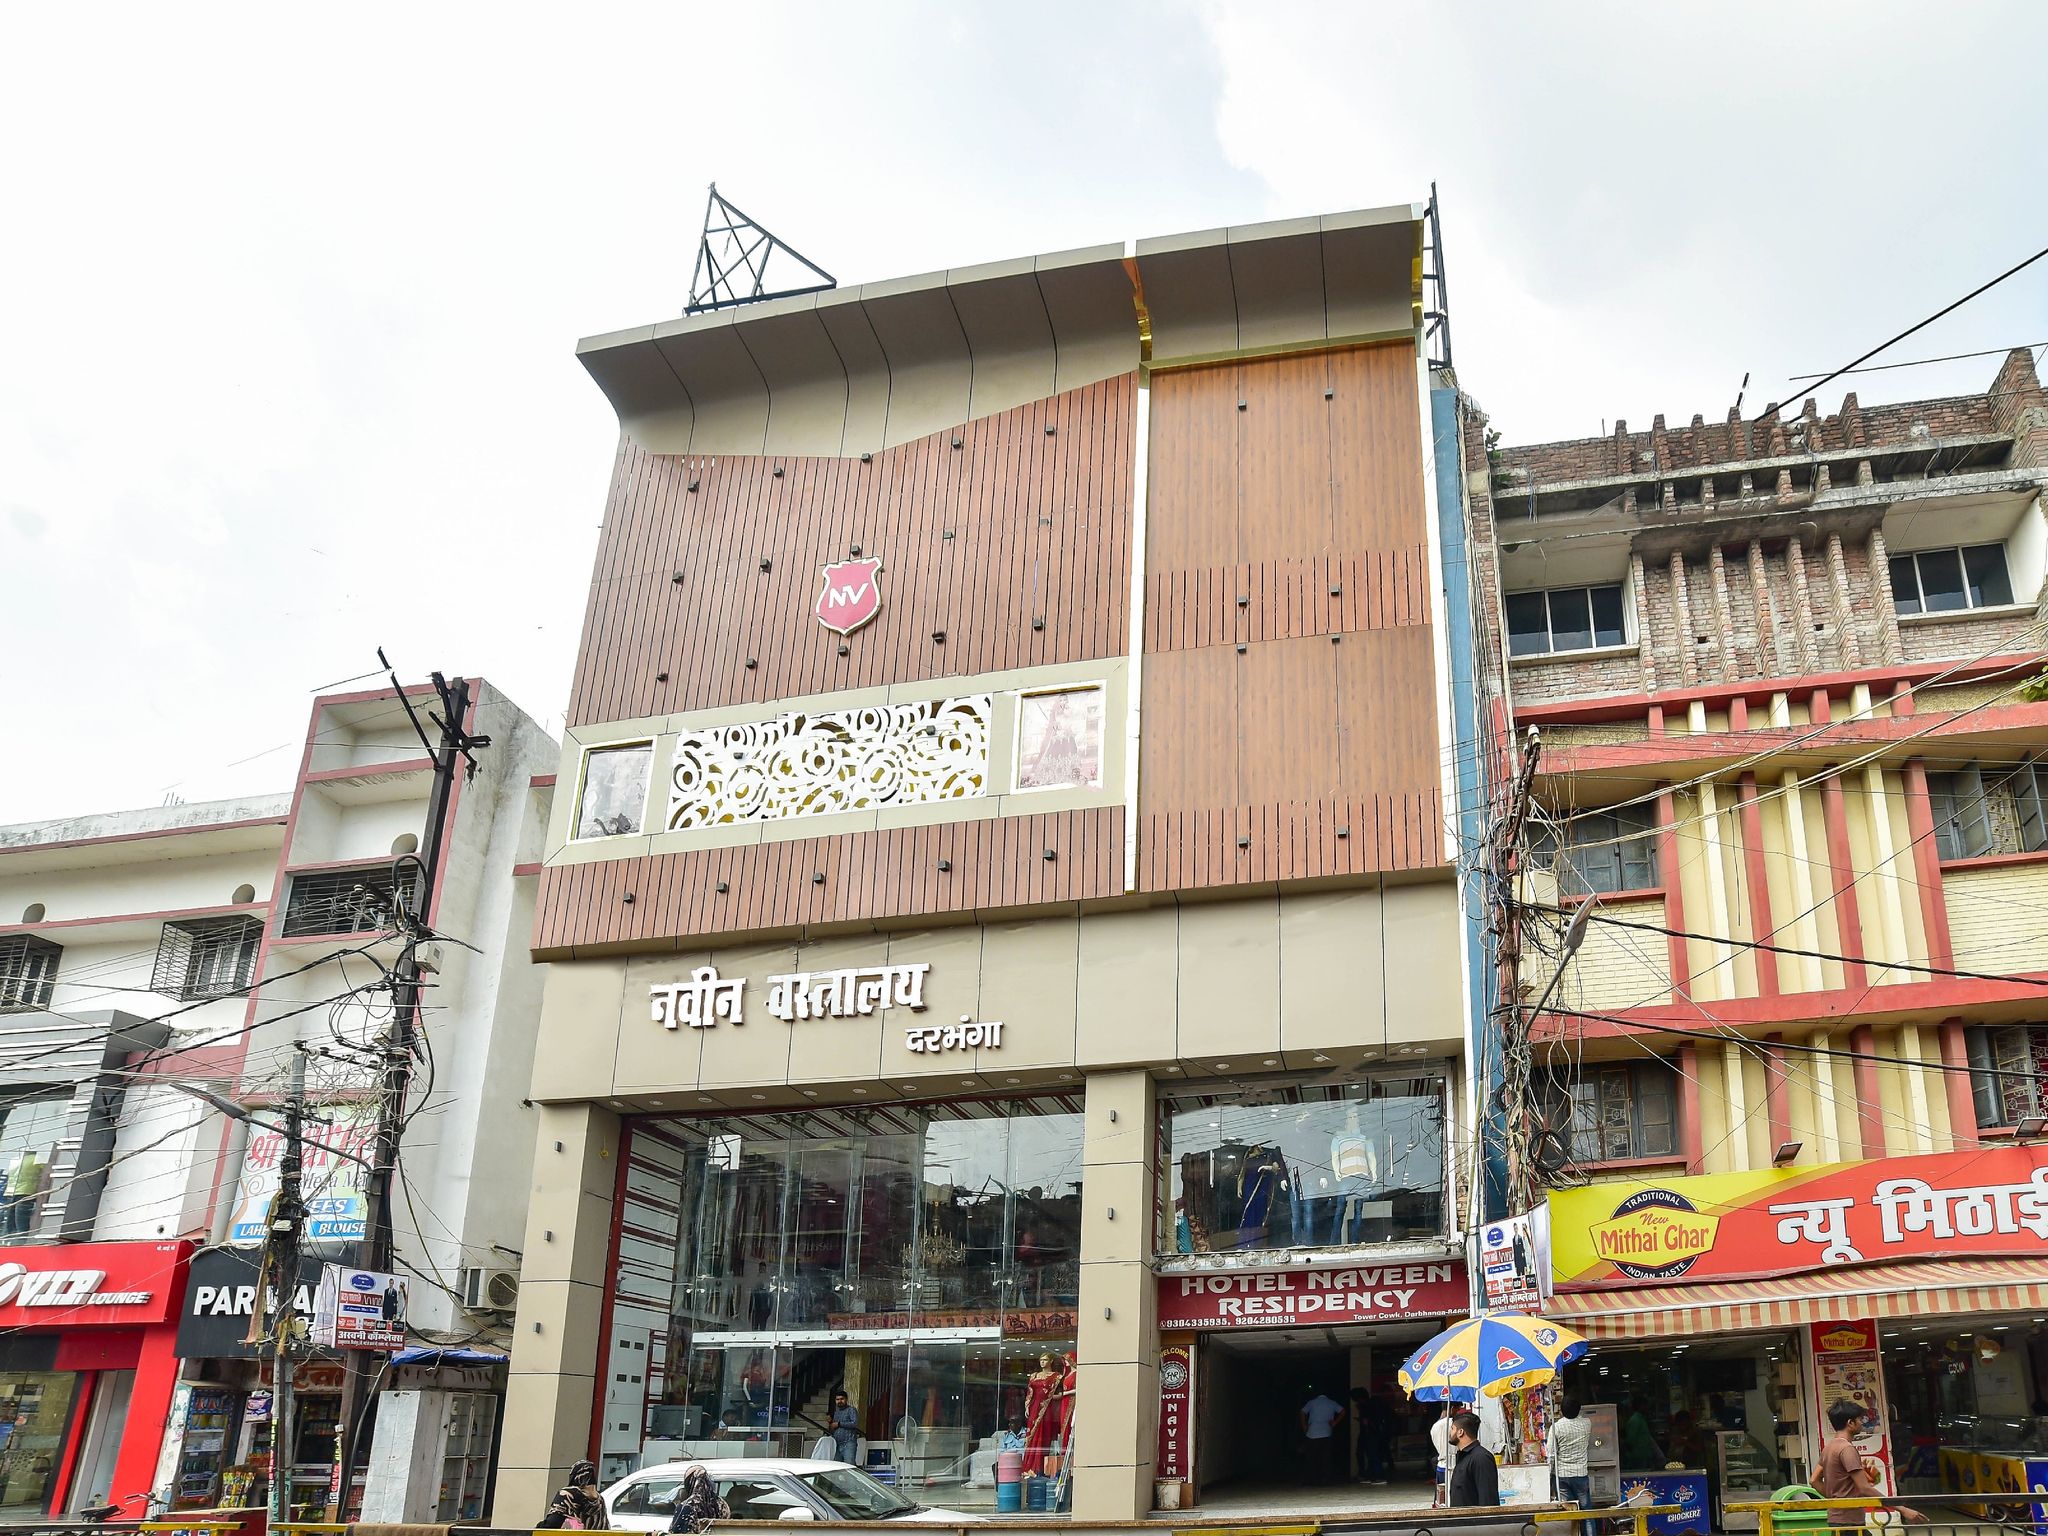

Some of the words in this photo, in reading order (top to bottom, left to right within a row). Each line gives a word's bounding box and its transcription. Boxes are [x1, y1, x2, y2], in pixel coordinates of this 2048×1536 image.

[828, 582, 869, 609] NV
[649, 966, 747, 1029] नवीन
[905, 1014, 1004, 1052] दरभंगा
[1625, 1191, 1681, 1210] TRADITIONAL
[1639, 1212, 1670, 1226] New
[1769, 1197, 1865, 1264] न्यू
[1600, 1226, 1659, 1255] Mithai
[1664, 1224, 1710, 1251] Ghar
[1181, 1274, 1296, 1296] HOTEL
[1307, 1265, 1452, 1290] NAVEEN
[1626, 1265, 1656, 1279] INDIAN
[1660, 1261, 1687, 1279] TASTE
[87, 1291, 152, 1305] LOUNGE
[1217, 1288, 1417, 1317] RESIDENCY
[1353, 1313, 1377, 1321] Tower
[1166, 1403, 1178, 1475] NAVEEN
